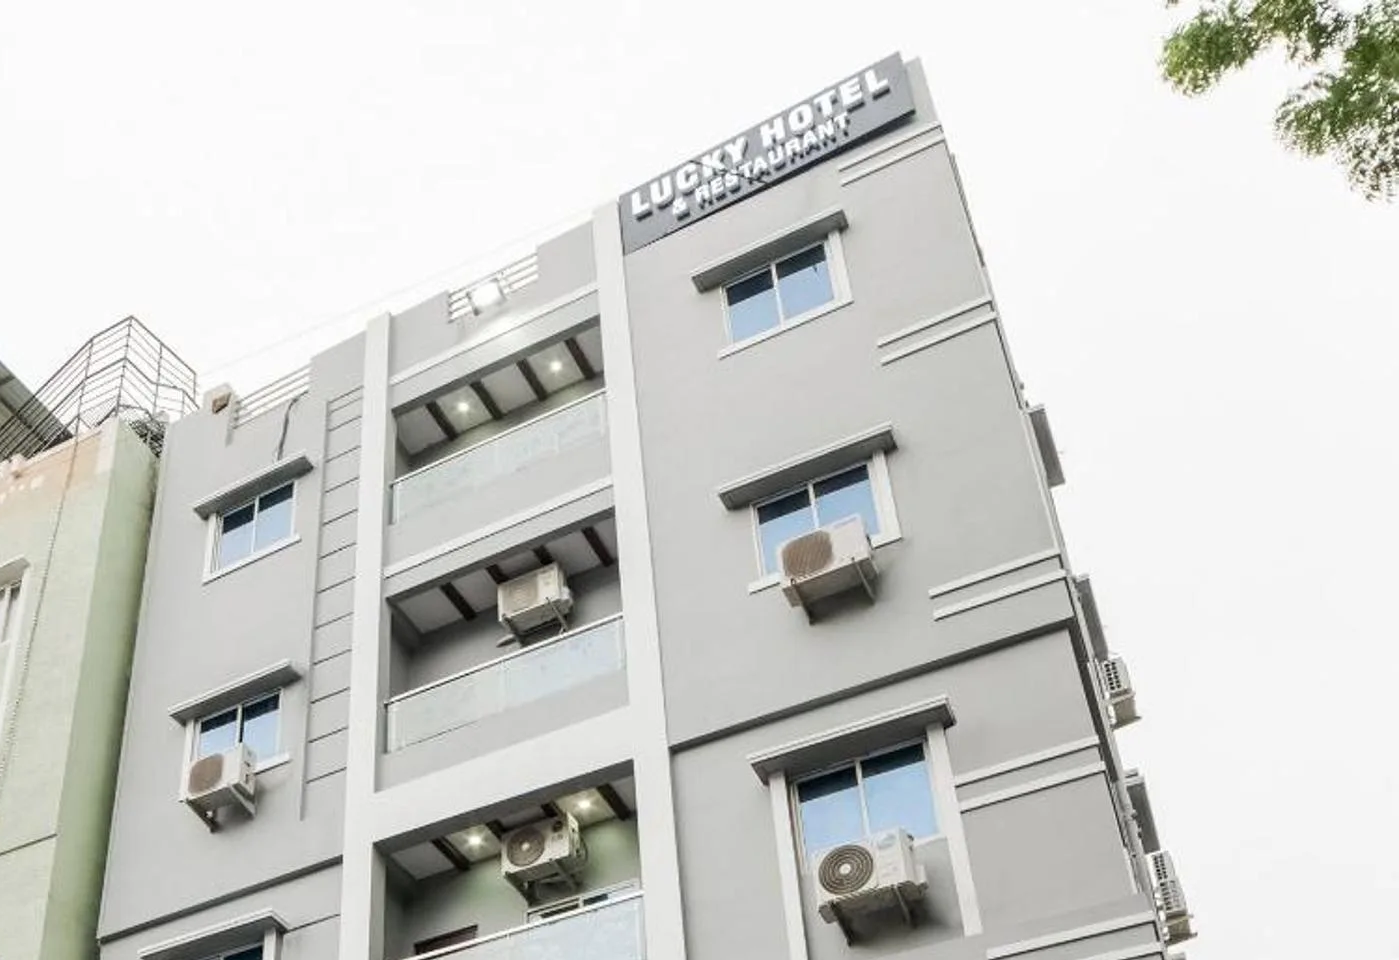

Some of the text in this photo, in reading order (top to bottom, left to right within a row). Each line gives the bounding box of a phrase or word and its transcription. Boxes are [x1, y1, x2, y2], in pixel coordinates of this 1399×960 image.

[630, 69, 890, 217] LUCKY HOTEL
[672, 111, 850, 217] & RESTAURANT
